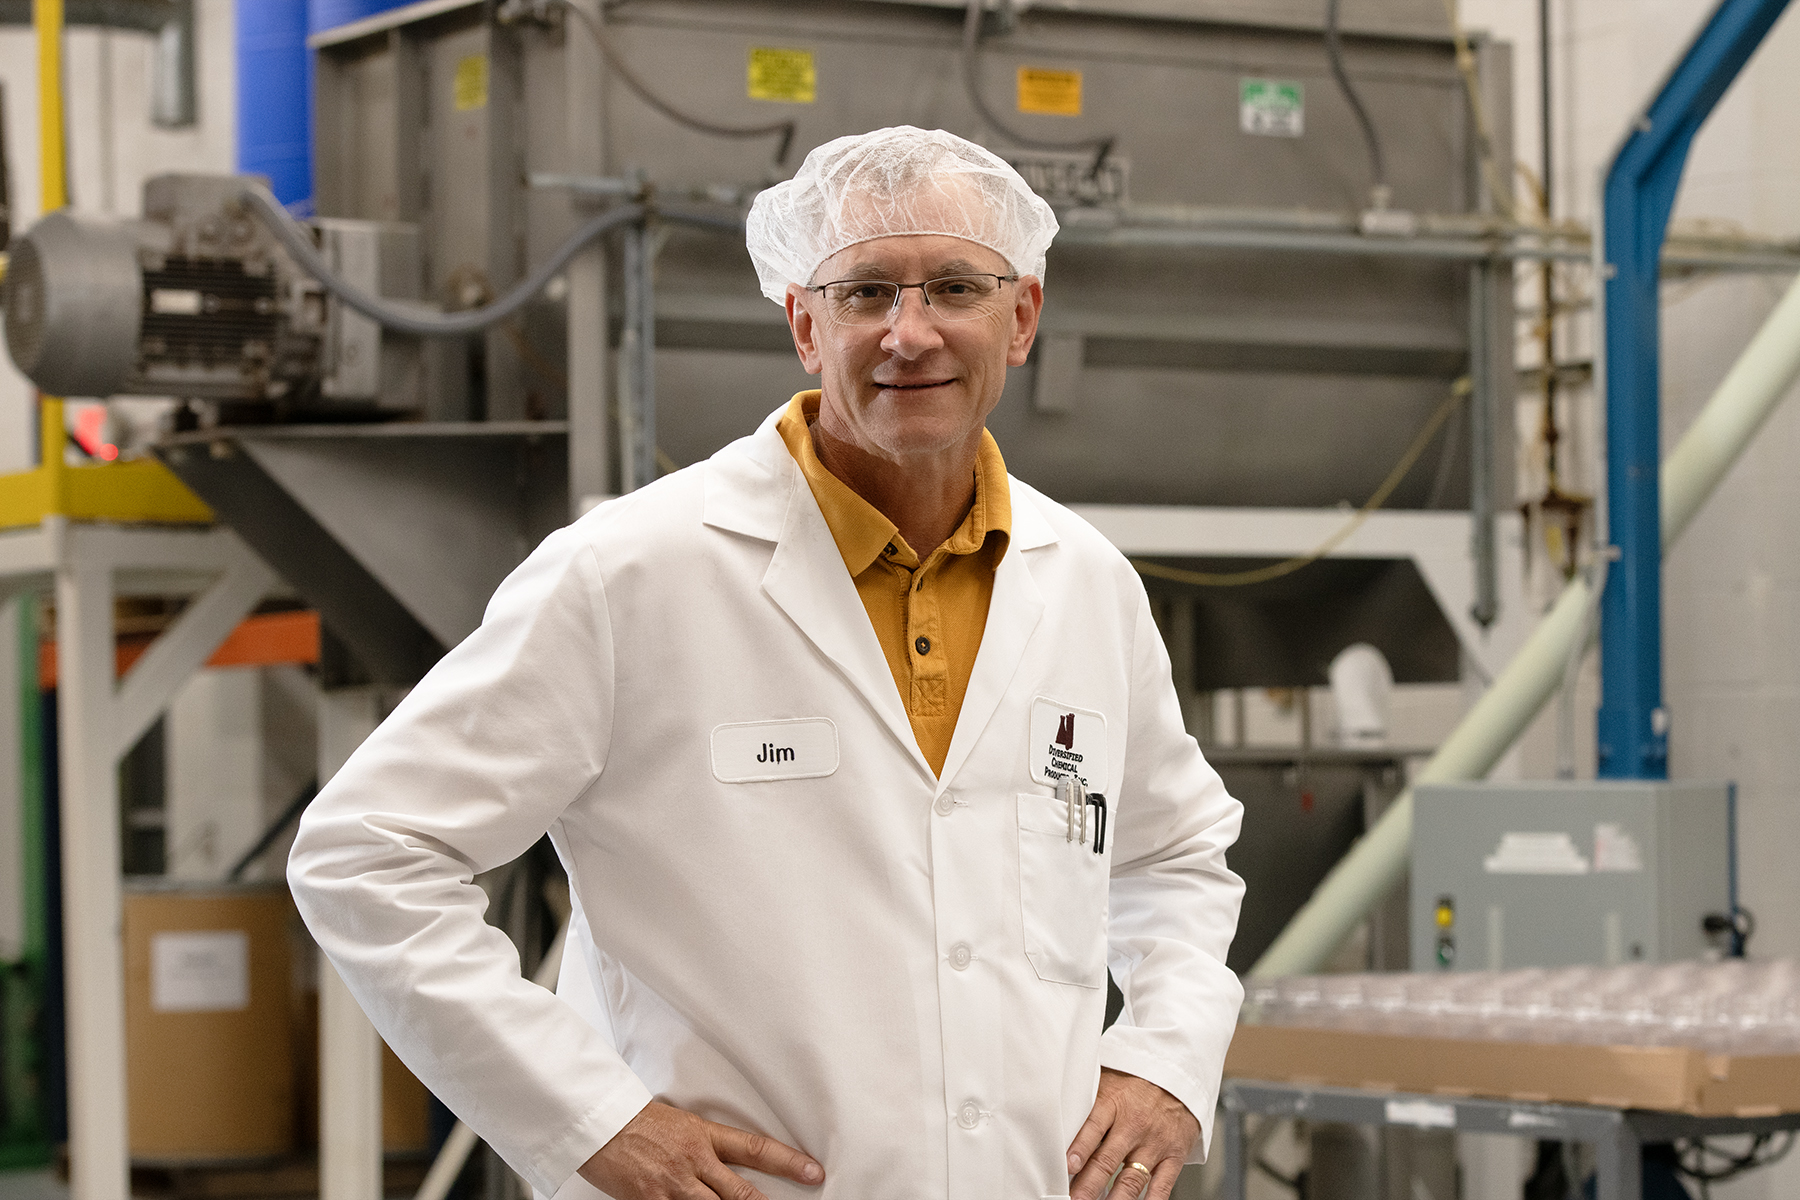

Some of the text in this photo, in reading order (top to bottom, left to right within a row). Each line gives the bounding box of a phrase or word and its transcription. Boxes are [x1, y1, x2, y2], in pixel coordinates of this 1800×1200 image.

[757, 743, 795, 764] Jim
[1048, 744, 1083, 763] DIVERSIFIED
[1051, 757, 1078, 773] CHEMICAL
[1044, 766, 1088, 787] PRODU C.
